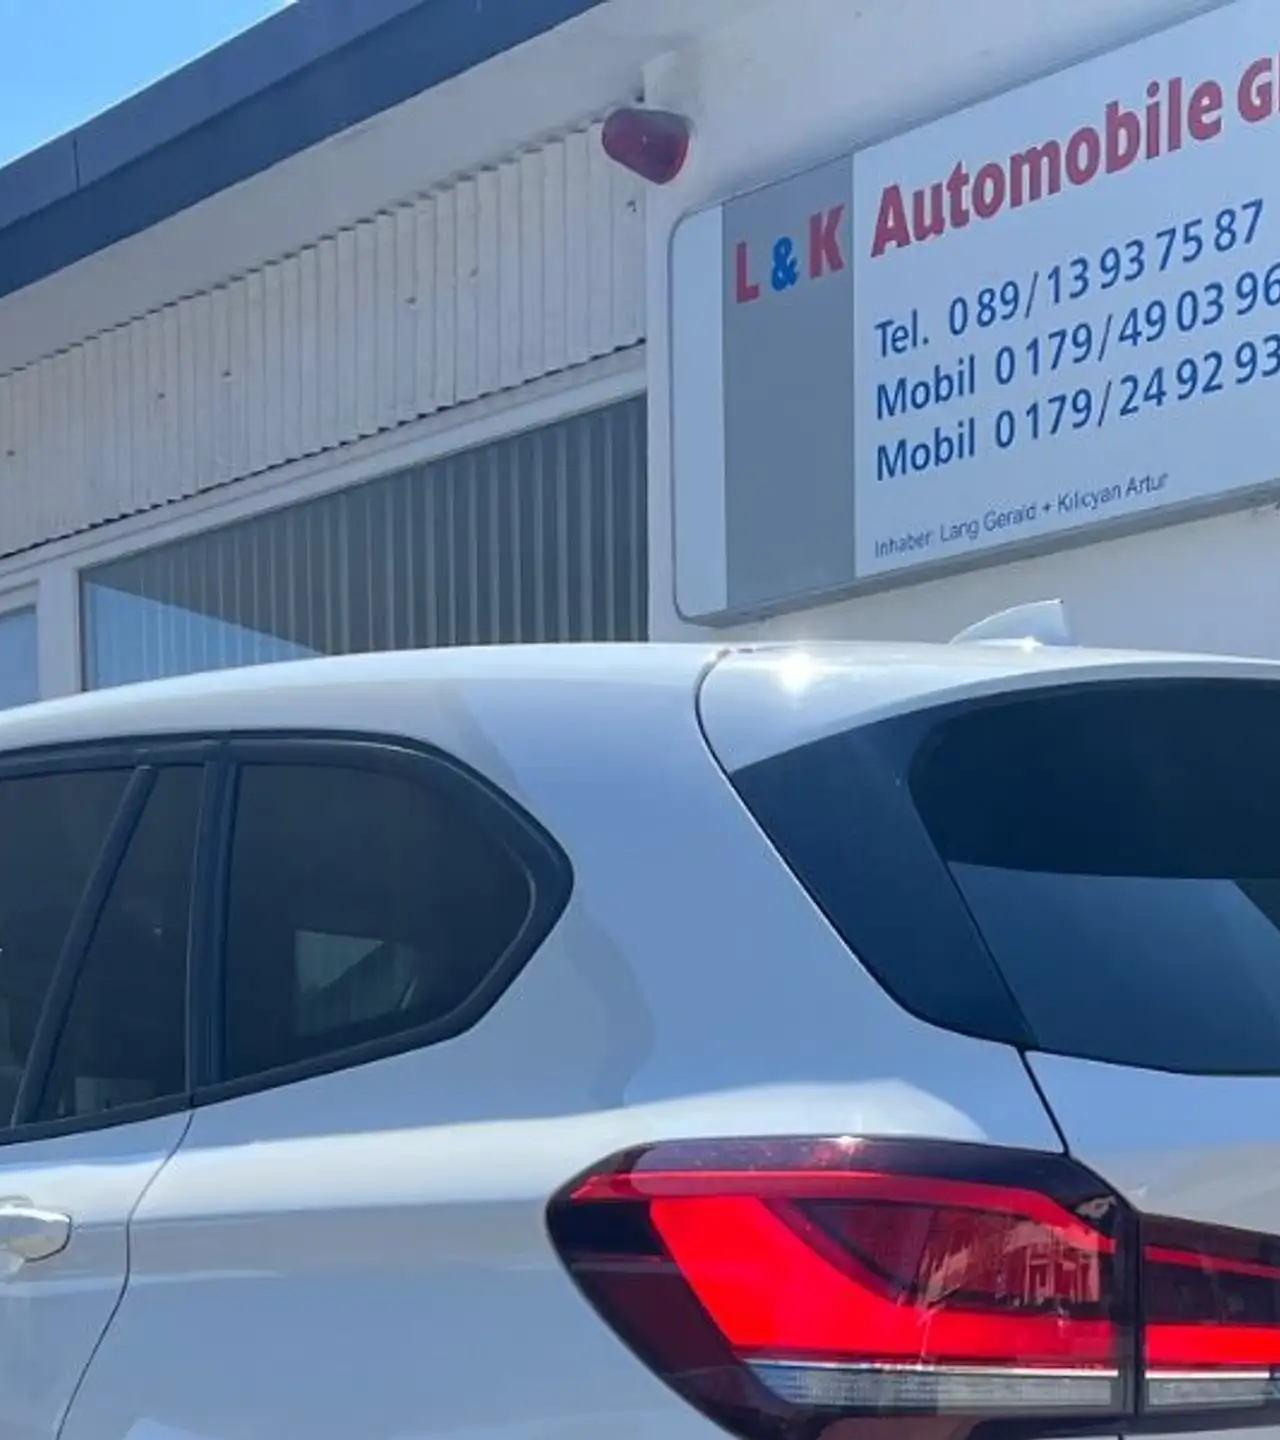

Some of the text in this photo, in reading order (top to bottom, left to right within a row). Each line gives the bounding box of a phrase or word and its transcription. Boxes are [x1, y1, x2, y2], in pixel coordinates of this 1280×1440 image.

[735, 240, 760, 304] L
[771, 235, 801, 293] &
[808, 202, 846, 280] K
[871, 76, 1224, 258] Automobile
[874, 308, 929, 358] Tel.
[876, 353, 975, 421] Mobil
[876, 416, 975, 482] Mobil
[940, 520, 980, 542] Lang
[1125, 471, 1169, 498] Artur
